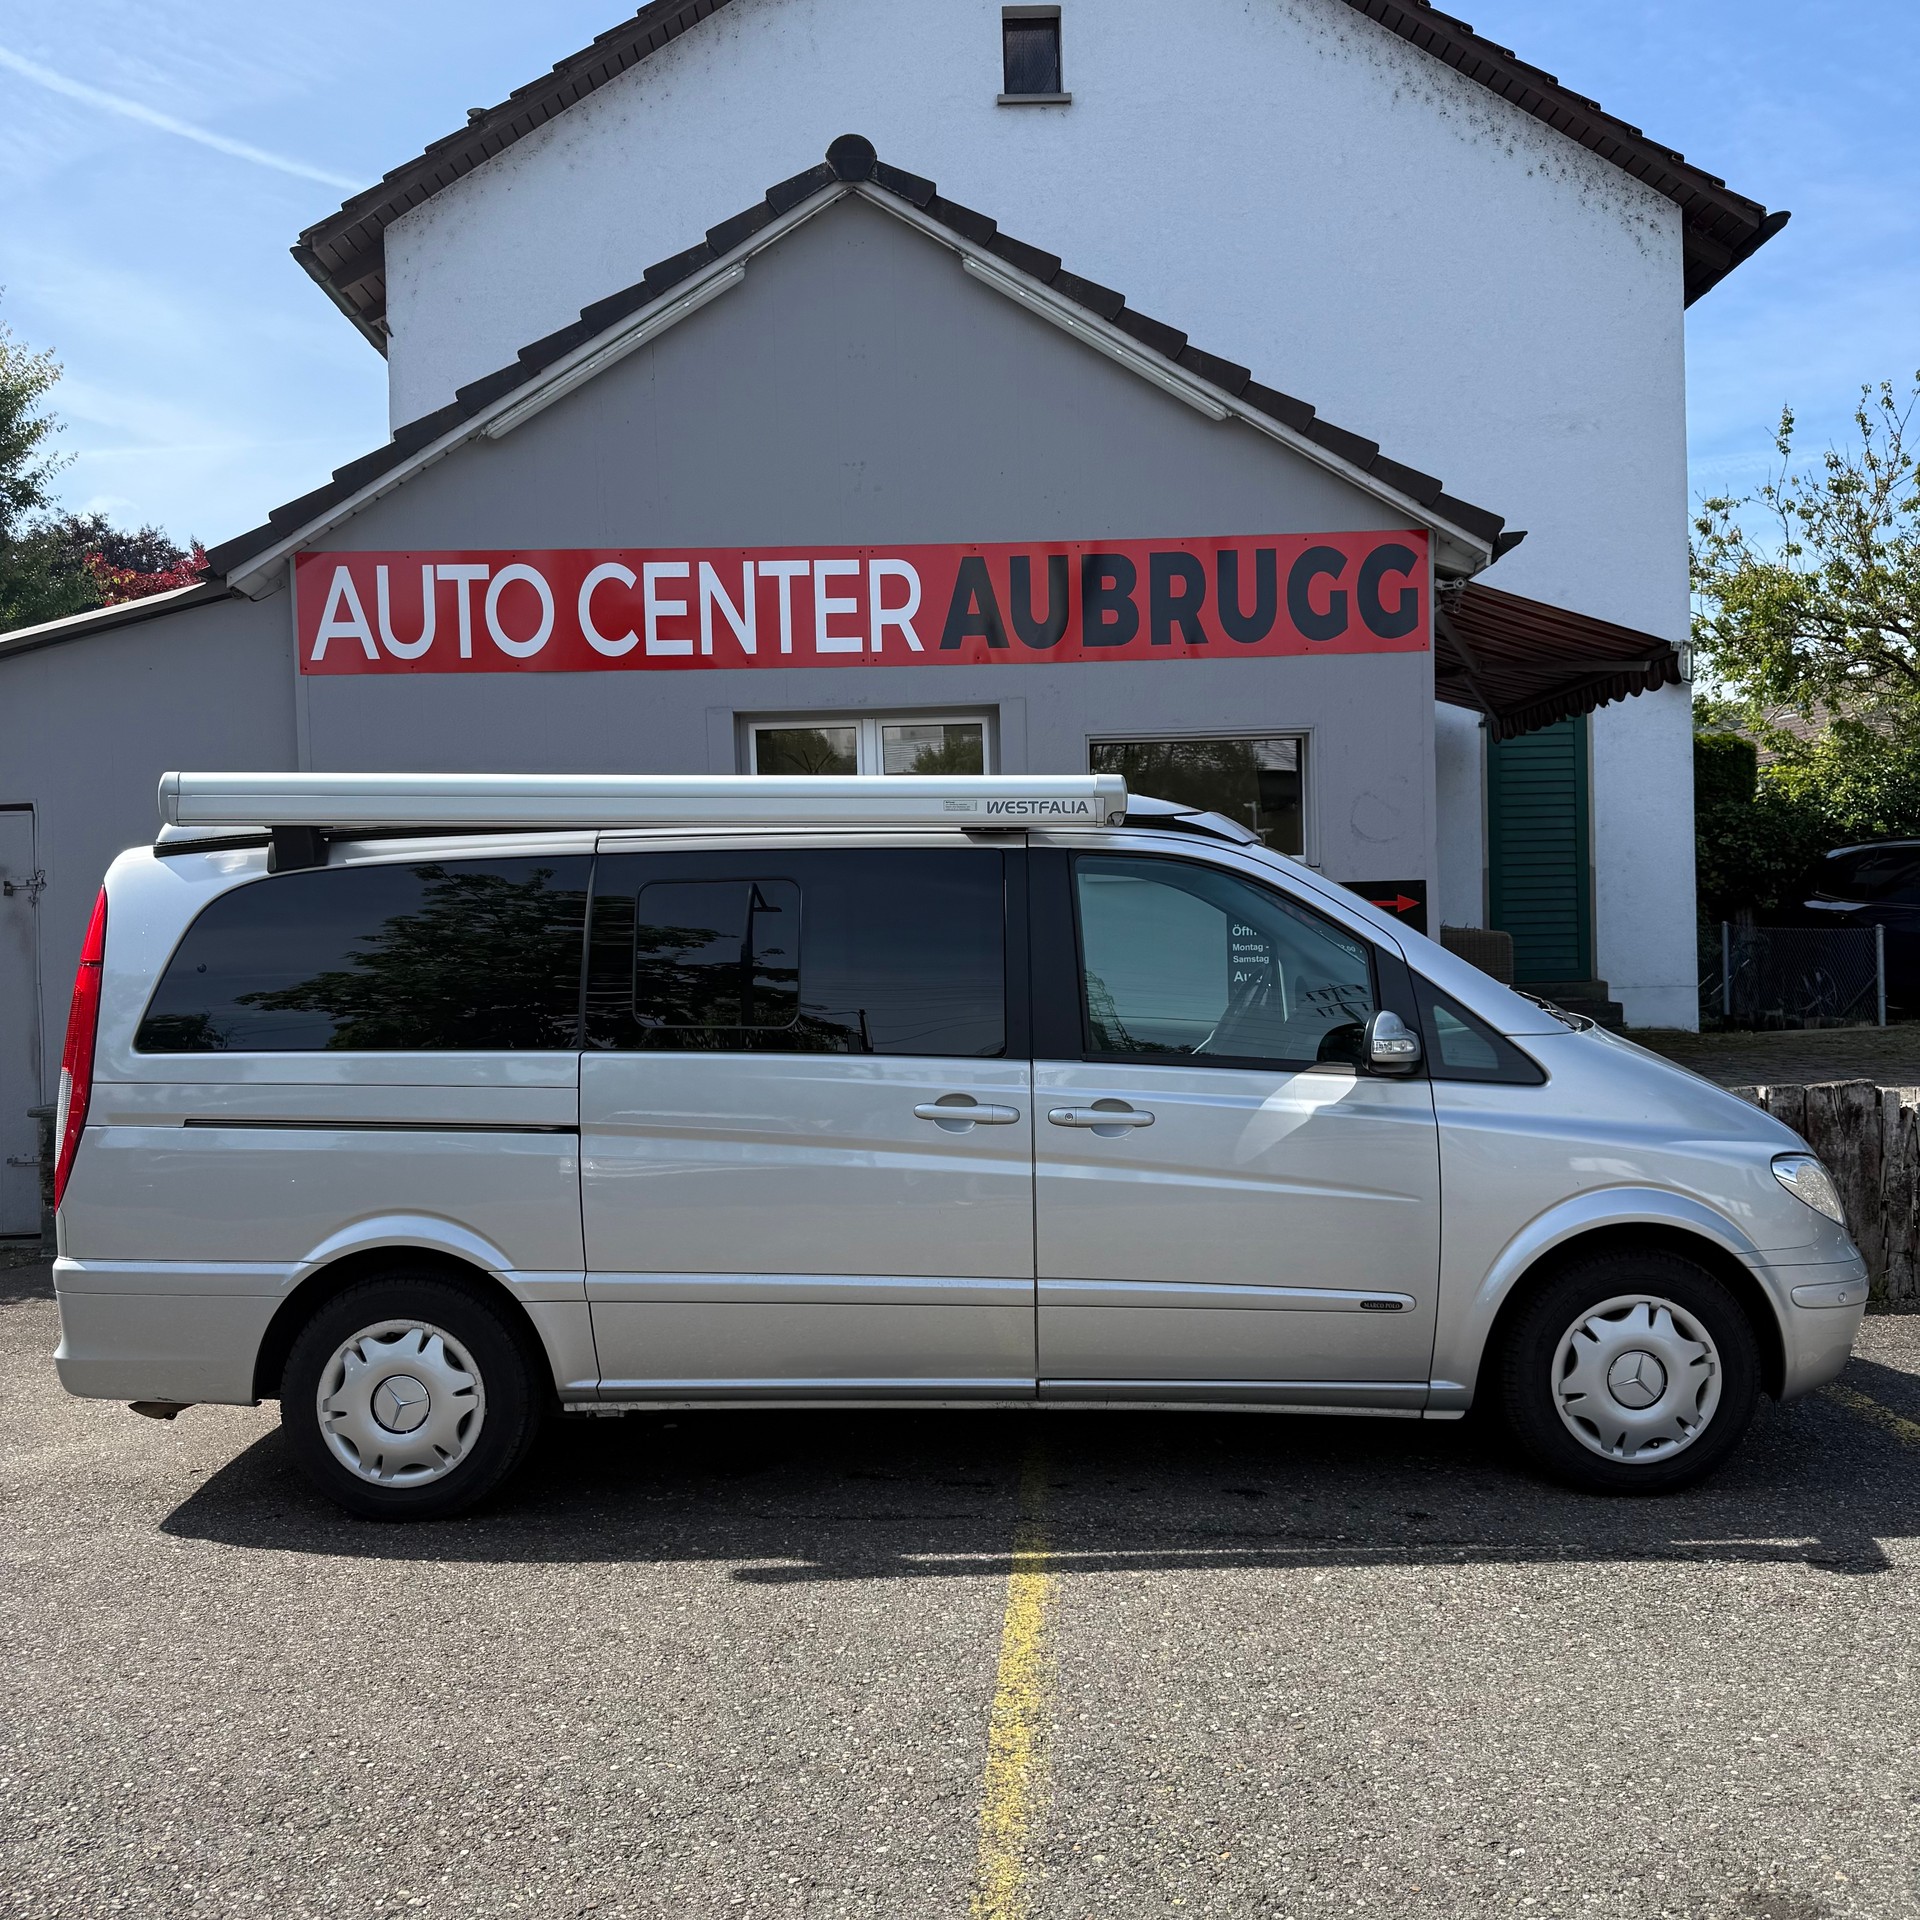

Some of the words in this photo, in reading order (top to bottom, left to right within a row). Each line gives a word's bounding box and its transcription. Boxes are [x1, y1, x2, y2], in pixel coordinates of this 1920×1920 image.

[310, 563, 555, 661] AUTO
[577, 558, 925, 657] CENTER
[939, 543, 1419, 650] AUBRUGG
[986, 801, 1089, 814] WESTFALIA
[1232, 943, 1264, 952] Montag
[1233, 955, 1270, 964] Samstag
